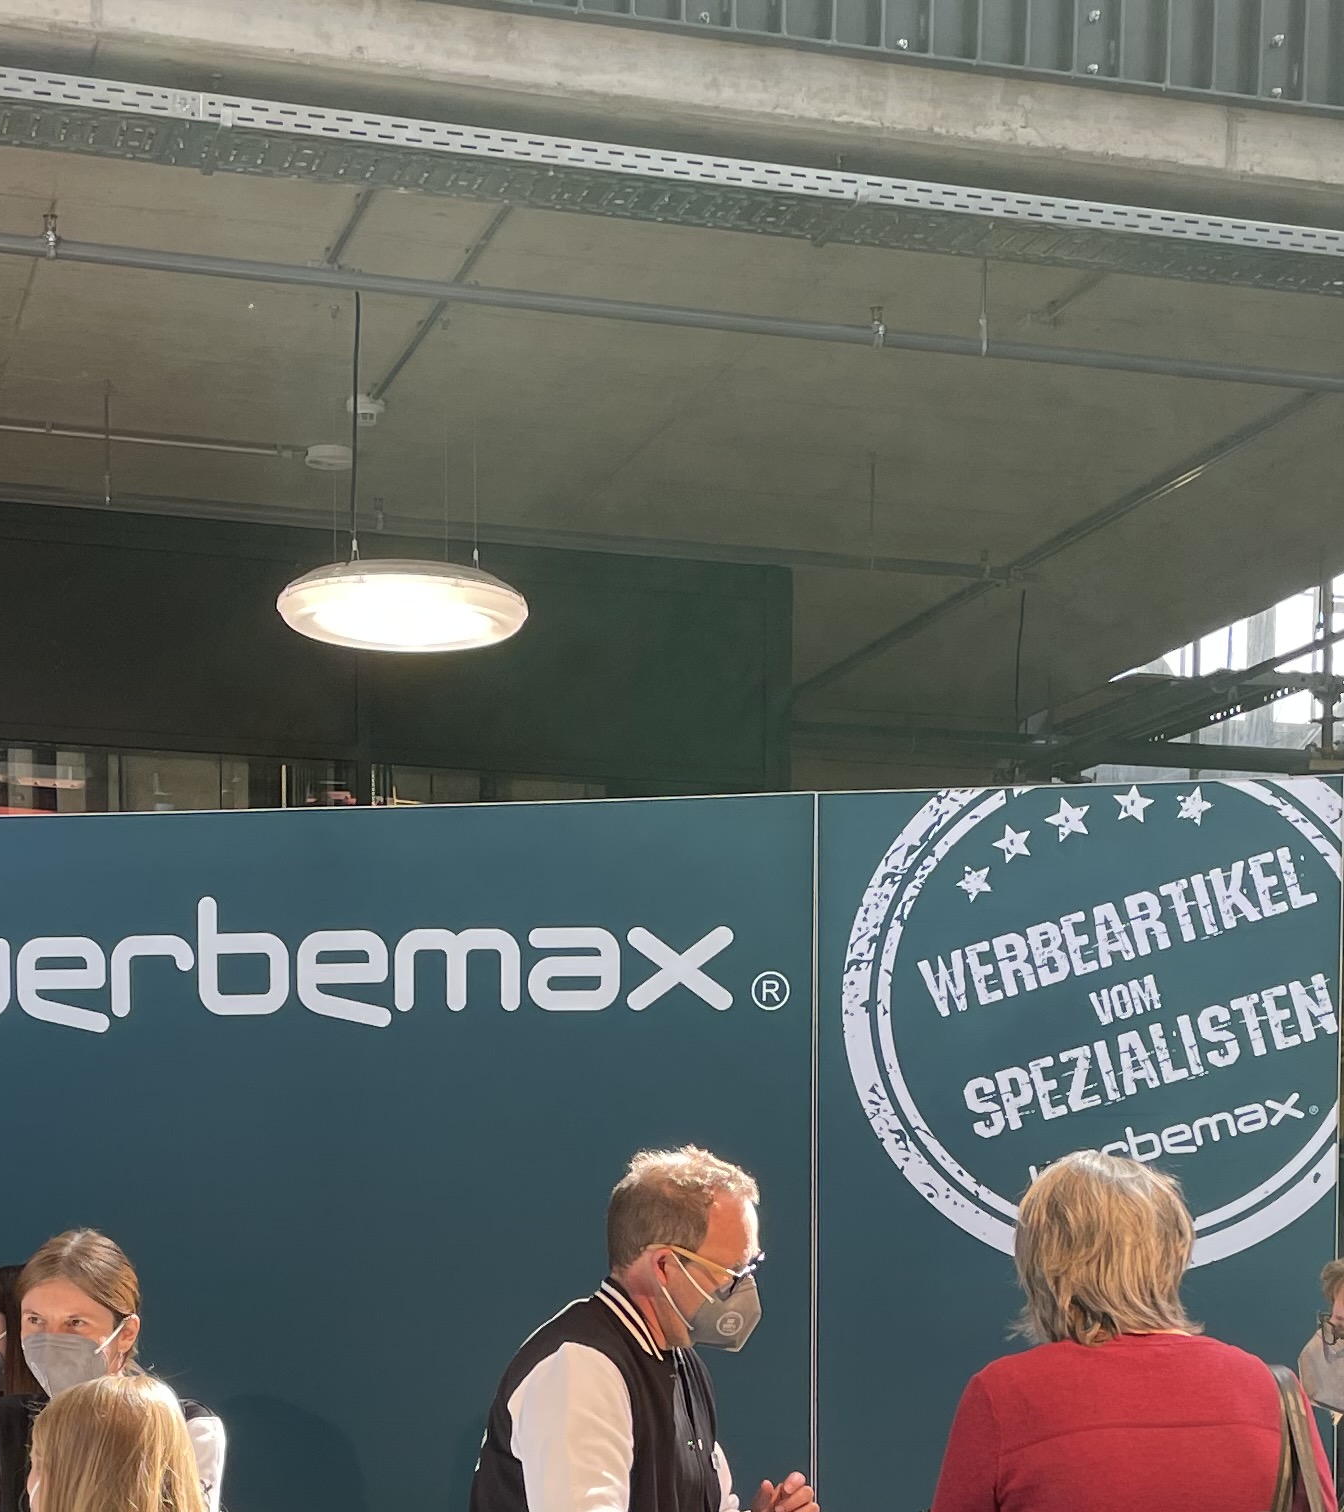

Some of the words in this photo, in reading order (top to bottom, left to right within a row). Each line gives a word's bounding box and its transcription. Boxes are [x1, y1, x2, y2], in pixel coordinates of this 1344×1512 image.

[917, 846, 1318, 1017] WERBEARTIKEL
[1088, 974, 1162, 1026] VOM
[963, 973, 1339, 1138] SPEZIALISTEN
